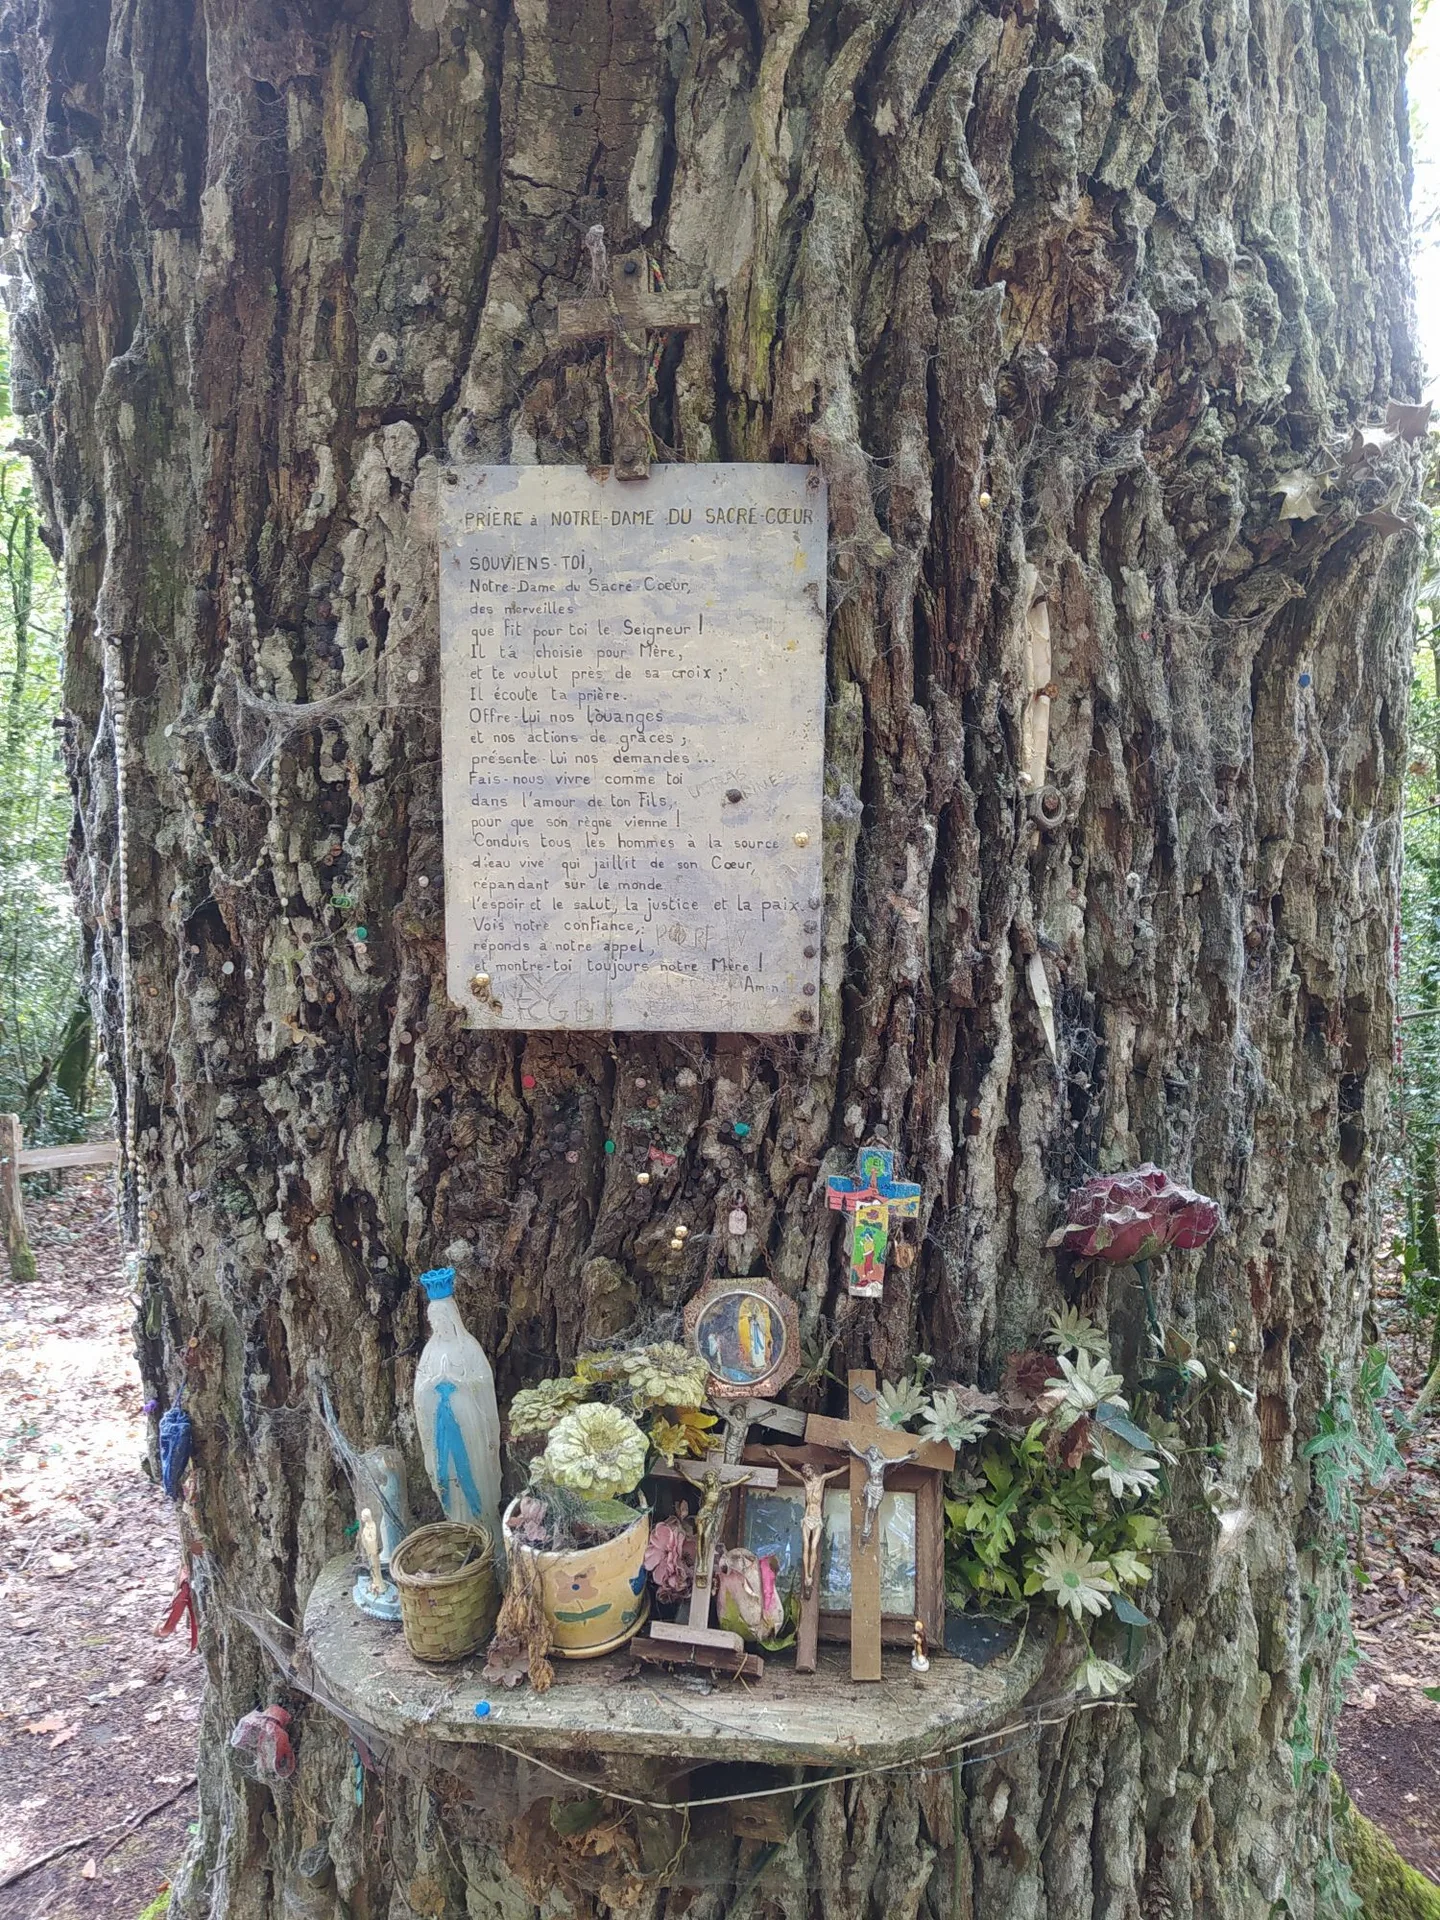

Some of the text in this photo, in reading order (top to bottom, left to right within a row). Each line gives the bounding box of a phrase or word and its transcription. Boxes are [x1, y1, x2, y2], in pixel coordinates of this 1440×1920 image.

[465, 506, 523, 526] PRIÈRE
[531, 514, 538, 526] à
[552, 510, 654, 526] NOTRE-DAME
[669, 509, 691, 524] DU
[470, 579, 555, 593] Notre-Dame
[566, 580, 581, 591] du
[470, 603, 574, 614] des merveilles
[472, 628, 494, 645] que
[504, 620, 521, 636] fit
[534, 628, 563, 645] pour
[570, 623, 587, 635] toi
[598, 623, 610, 634] le
[624, 620, 690, 645] Seigneur
[471, 644, 485, 658] Il
[536, 644, 583, 658] choisie
[597, 650, 627, 667] pour
[640, 643, 682, 661] Mère,
[470, 668, 482, 680] et
[492, 667, 505, 680] te
[514, 667, 558, 679] voulut
[572, 665, 603, 687] près
[616, 667, 631, 678] de
[645, 668, 660, 678] sa
[672, 666, 711, 678] croix
[470, 687, 482, 701] Il
[494, 687, 538, 701] écoute
[552, 688, 567, 700] ta
[550, 713, 574, 722] nos
[471, 732, 482, 744] et
[494, 734, 515, 742] nos
[528, 731, 578, 743] actions
[590, 730, 606, 742] de
[620, 731, 673, 751] grâces
[576, 755, 598, 764] nos
[613, 751, 690, 763] demandes
[556, 772, 590, 784] vivre
[605, 775, 656, 785] comme
[667, 772, 682, 785] toi
[472, 791, 672, 810] dans l'amour de ton Fils,
[472, 818, 501, 836] pour
[511, 818, 534, 835] que
[547, 817, 568, 827] son
[578, 817, 612, 835] règne
[625, 816, 667, 827] vienne
[473, 832, 779, 849] Conduis tous les hommes à la source
[520, 857, 544, 868] vive
[562, 859, 580, 878] qui
[588, 856, 636, 878] jaillit
[651, 857, 664, 868] de
[678, 860, 698, 868] son
[474, 878, 663, 897] répandant sur le monde
[472, 899, 524, 916] l'espoir
[531, 899, 541, 910] et
[553, 899, 563, 909] le
[574, 897, 617, 913] salut,
[626, 897, 638, 911] la
[644, 898, 699, 921] justice
[714, 898, 729, 910] et
[738, 895, 752, 911] la
[473, 918, 504, 931] Vois
[515, 919, 549, 931] notre
[474, 939, 530, 960] réponds
[540, 939, 547, 951] à
[555, 940, 592, 951] notre
[475, 960, 487, 971] et
[588, 959, 649, 980] toujours
[660, 961, 697, 972] notre
